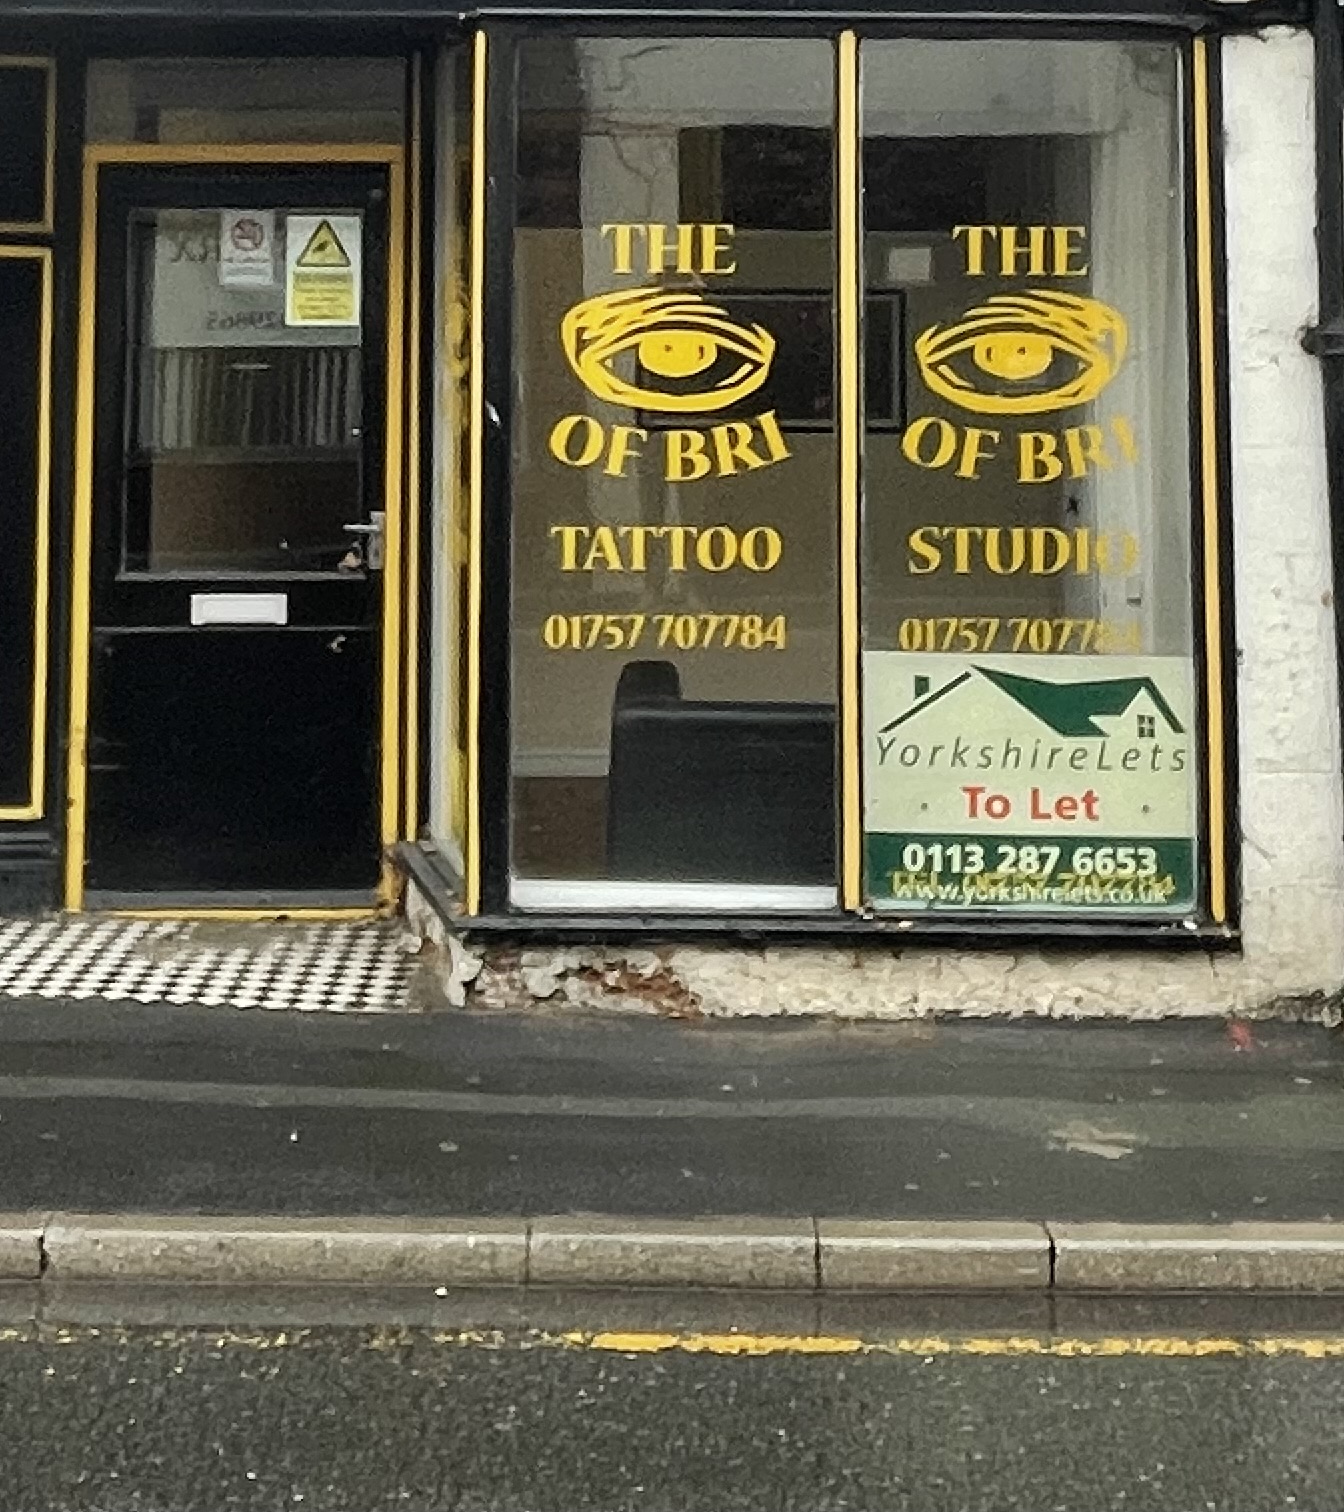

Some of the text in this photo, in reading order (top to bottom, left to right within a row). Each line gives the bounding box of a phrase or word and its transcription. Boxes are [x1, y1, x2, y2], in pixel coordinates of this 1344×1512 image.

[601, 222, 737, 275] THE
[952, 225, 1090, 277] THE
[549, 409, 793, 482] OF BRI
[901, 414, 1139, 484] OF BRI
[549, 525, 783, 573] TATTOO
[908, 525, 1139, 577] STUDIO
[544, 614, 787, 651] 01757 707784
[898, 618, 1001, 653] 01757
[877, 735, 1186, 772] YorkshireLets
[961, 786, 1099, 822] To Let
[902, 842, 1158, 877] 0113 287 6653
